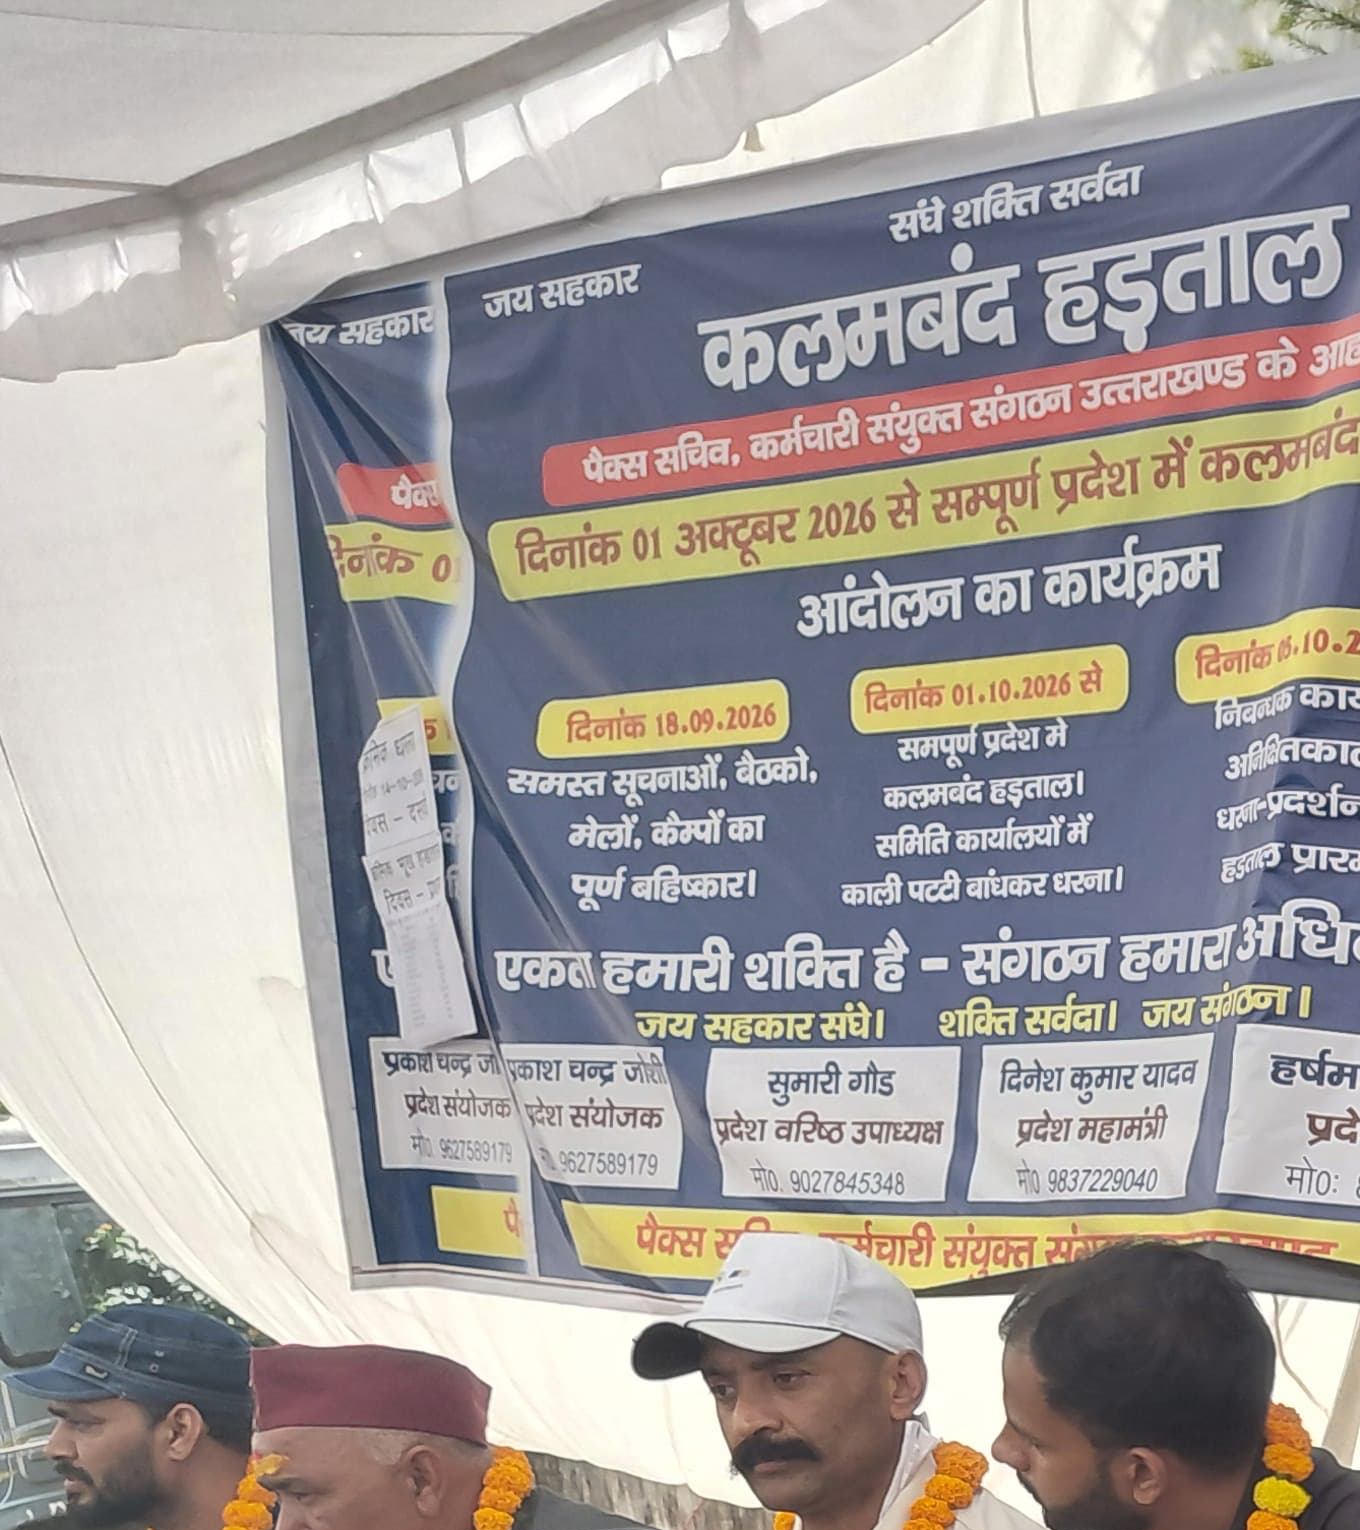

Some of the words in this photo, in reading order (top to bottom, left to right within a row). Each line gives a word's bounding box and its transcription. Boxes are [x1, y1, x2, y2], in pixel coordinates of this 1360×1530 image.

[889, 196, 946, 243] संघे
[951, 181, 1043, 230] शक्ति
[1049, 160, 1145, 210] सर्वदा
[482, 285, 532, 318] जय
[539, 264, 642, 308] सहकार
[698, 242, 1021, 392] कलमबंद
[1037, 204, 1350, 353] हड़ताल
[583, 447, 648, 483] पैक्स
[654, 431, 740, 472] सचिव,
[748, 407, 860, 462] कर्मचारी
[866, 401, 963, 454] संयुक्त
[970, 385, 1073, 429] संगठन
[1079, 354, 1248, 410] उत्तराखण्ड
[1256, 337, 1297, 381] के
[515, 522, 623, 576] दिनांक
[633, 527, 662, 560] 01
[675, 507, 801, 567] अक्टूबर
[808, 499, 876, 539] 2026
[886, 478, 920, 529] से
[931, 456, 1041, 534] सम्पूर्ण
[1051, 449, 1141, 514] प्रदेश
[1151, 435, 1194, 490] में
[796, 570, 965, 638] आंदोलन
[974, 569, 1033, 615] का
[1044, 536, 1223, 608] कार्यक्रम
[1195, 640, 1274, 681] दिनांक
[864, 678, 944, 714] दिनांक
[952, 672, 1071, 706] 01.10.2026
[1080, 660, 1103, 694] से
[566, 708, 646, 744] दिनांक
[656, 702, 776, 738] 18.09.2026
[982, 722, 1040, 759] प्रदेश
[507, 768, 606, 797] समस्त
[884, 774, 984, 811] कलमबंद
[568, 813, 642, 851] मेलों,
[728, 813, 766, 843] का
[876, 823, 950, 859] समिति
[956, 815, 1062, 852] कार्यालयों
[1067, 813, 1094, 844] में
[570, 866, 625, 911] पूर्ण
[841, 873, 901, 907] काली
[967, 869, 1048, 899] बांधकर
[600, 934, 735, 995] हमारी
[744, 931, 863, 992] शक्ति
[872, 928, 911, 993] है
[961, 925, 1110, 986] संगठन
[1120, 923, 1238, 983] हमारा
[635, 1012, 697, 1040] जय
[703, 1012, 816, 1043] सहकार
[938, 996, 1016, 1038] शक्ति
[768, 1060, 841, 1105] सुमारी
[1000, 1059, 1065, 1095] दिनेश
[1070, 1063, 1138, 1104] कुमार
[1143, 1059, 1200, 1086] यादव
[570, 1100, 664, 1129] संयोजक
[714, 1110, 766, 1145] प्रदेश
[774, 1111, 846, 1145] वरिष्ठ
[852, 1120, 944, 1145] उपाध्यक्ष
[1016, 1109, 1070, 1148] प्रदेश
[1077, 1105, 1168, 1143] महामंत्री
[560, 1151, 658, 1176] 9627589179
[790, 1170, 905, 1195] 9027845348
[1048, 1169, 1158, 1193] 9837229040
